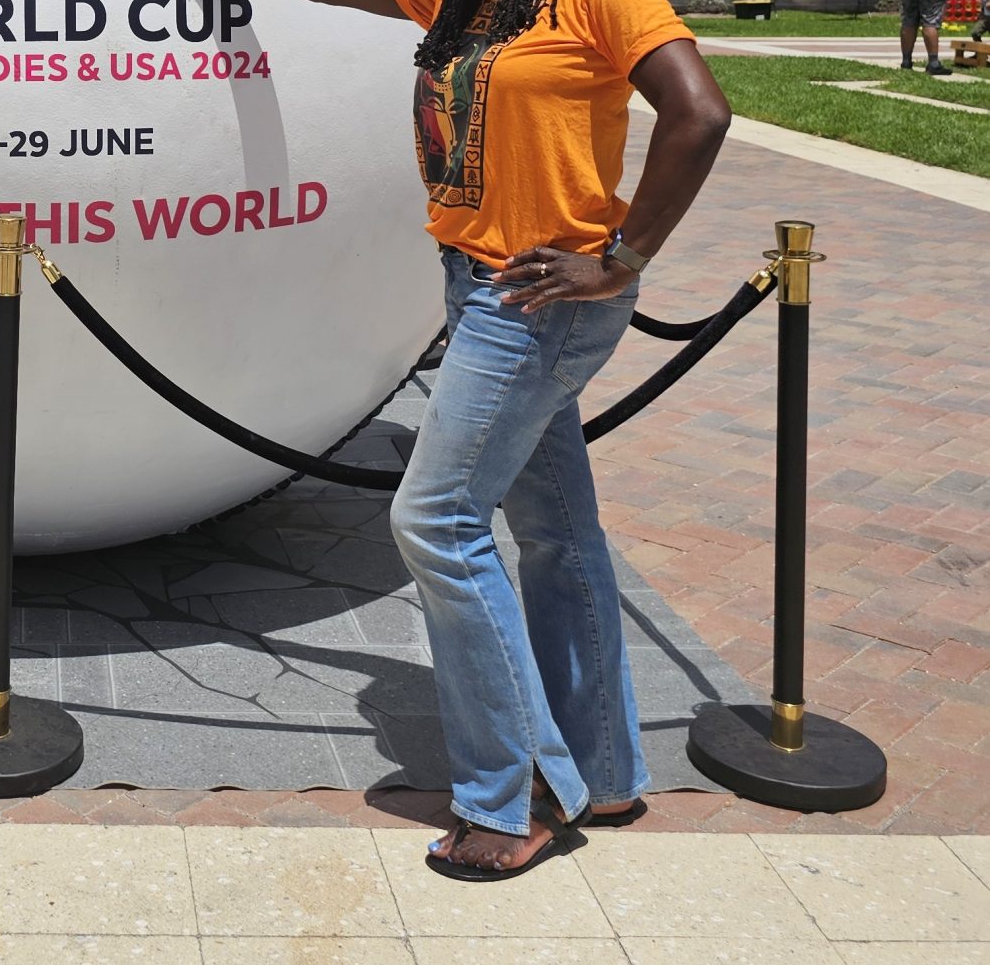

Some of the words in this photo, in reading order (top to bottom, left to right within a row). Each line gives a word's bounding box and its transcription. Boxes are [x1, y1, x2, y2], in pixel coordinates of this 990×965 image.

[78, 53, 101, 81] &
[110, 52, 182, 81] USA
[193, 51, 271, 80] 2024
[60, 128, 154, 157] JUNE
[132, 181, 328, 240] WORLD
